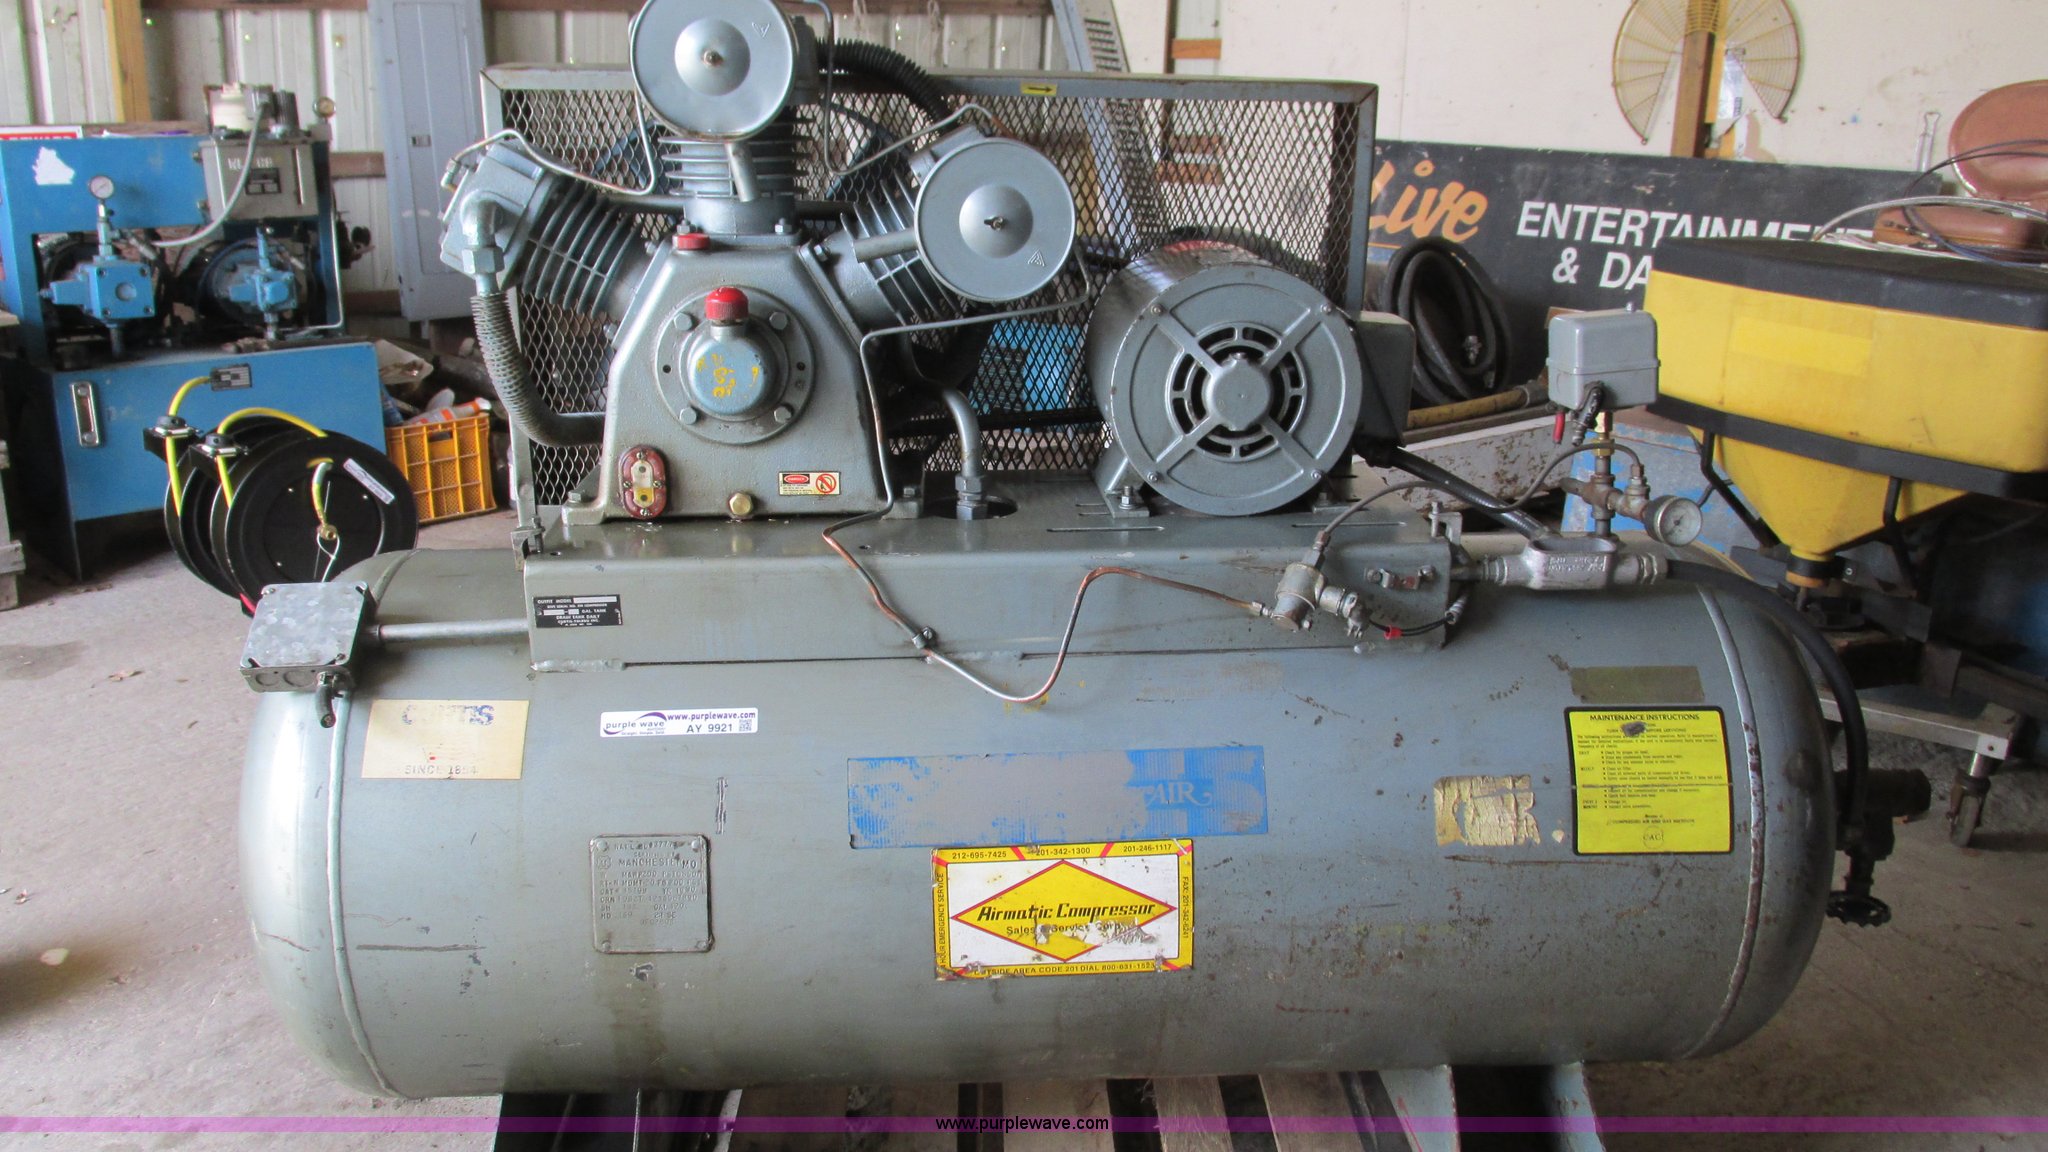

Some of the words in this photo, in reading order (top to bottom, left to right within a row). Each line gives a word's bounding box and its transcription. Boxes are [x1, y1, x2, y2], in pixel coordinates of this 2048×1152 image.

[1368, 159, 1488, 243] Live
[1516, 200, 1874, 248] ENTERTAINM
[1551, 247, 1580, 284] &
[667, 711, 756, 722] www.purplewave.com
[1646, 713, 1700, 721] INSTRUCTIONS
[605, 721, 637, 729] purple
[639, 720, 665, 728] wave
[686, 724, 702, 733] AY
[707, 723, 733, 732] 9921
[1035, 846, 1091, 857] 201-342-1300
[1123, 843, 1172, 853] 201-246-1117
[952, 850, 1007, 860] 212-695-7425
[936, 872, 944, 903] SERVICE
[977, 904, 1053, 921] Airmatic
[1056, 902, 1155, 924] Compressor
[937, 903, 946, 945] EMERGENCY
[1006, 926, 1035, 935] Sales
[1013, 966, 1037, 975] AREA
[1039, 965, 1063, 973] CODE
[1080, 963, 1100, 972] DIAL
